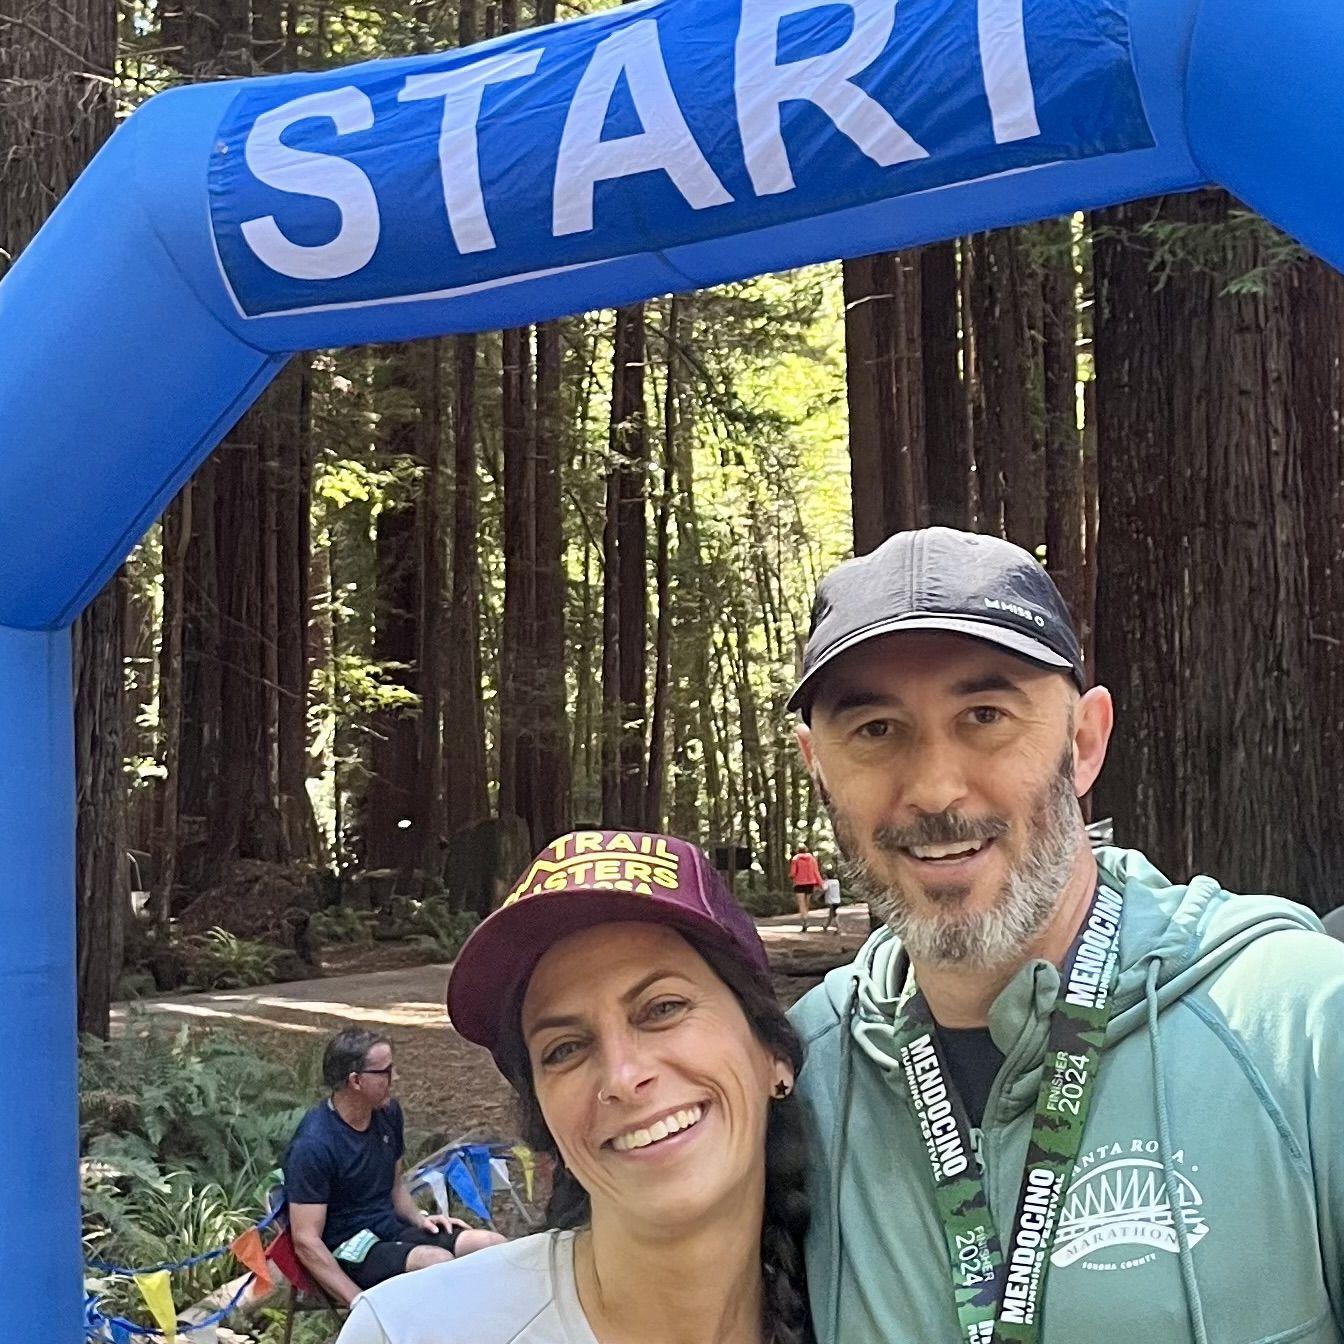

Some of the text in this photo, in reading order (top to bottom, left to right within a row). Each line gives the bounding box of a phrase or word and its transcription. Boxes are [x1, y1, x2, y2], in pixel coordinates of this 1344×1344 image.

[548, 832, 679, 862] TRAIL
[1065, 884, 1123, 1008] MENDOCINO
[908, 1033, 968, 1177] MENDOCINO
[1046, 1051, 1069, 1111] FINISHER
[1058, 1054, 1090, 1115] 2024
[900, 1046, 941, 1182] RUNNING FESTIVAL
[1071, 1139, 1184, 1177] ANTA ROA
[956, 1230, 984, 1287] 2024
[973, 1225, 995, 1282] FINISHER
[1000, 1168, 1055, 1324] MENDOCINO
[1064, 1226, 1178, 1258] MARATHON
[1024, 1251, 1045, 1325] RUNNING
